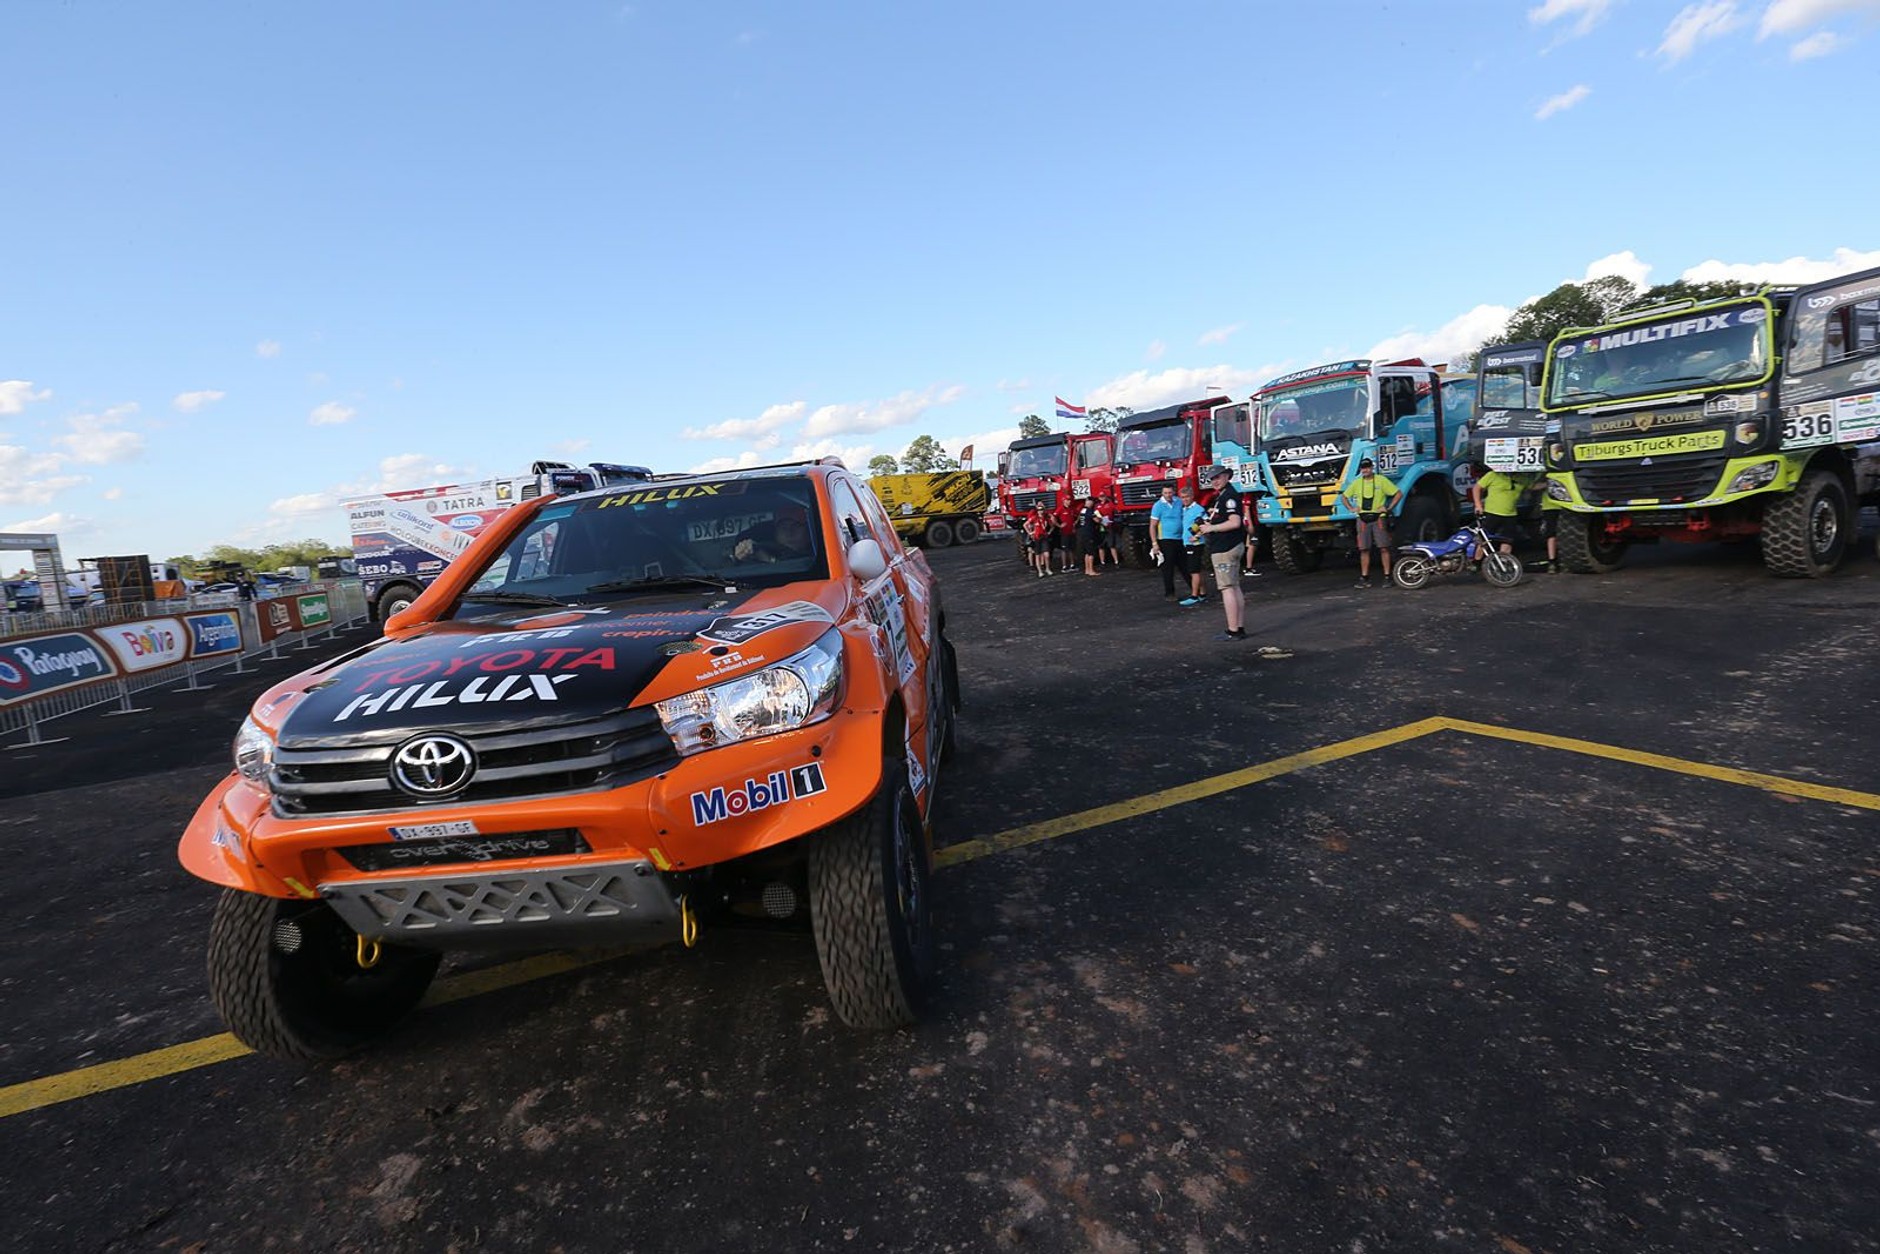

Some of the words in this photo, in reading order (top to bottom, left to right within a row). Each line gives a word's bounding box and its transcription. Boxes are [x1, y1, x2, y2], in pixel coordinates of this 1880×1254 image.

[1600, 312, 1732, 350] MULTIFIX
[1278, 364, 1341, 383] KAZAKHSTAN
[1591, 419, 1633, 432] WORLD
[1657, 411, 1702, 424] POWER
[1781, 413, 1833, 440] 536
[1276, 443, 1342, 462] ASTANA
[1635, 437, 1675, 454] Truck
[1678, 432, 1719, 449] Parts
[1380, 453, 1397, 469] 512
[1241, 470, 1257, 485] 512
[598, 483, 726, 509] HILUX
[1072, 485, 1090, 496] 522
[443, 497, 485, 510] TATRA
[351, 509, 385, 520] ALFUN
[358, 564, 388, 575] ŠEBO
[355, 648, 616, 693] TOYOTA
[333, 674, 578, 722] HILUX
[693, 773, 787, 824] Mobil
[800, 768, 813, 793] 1
